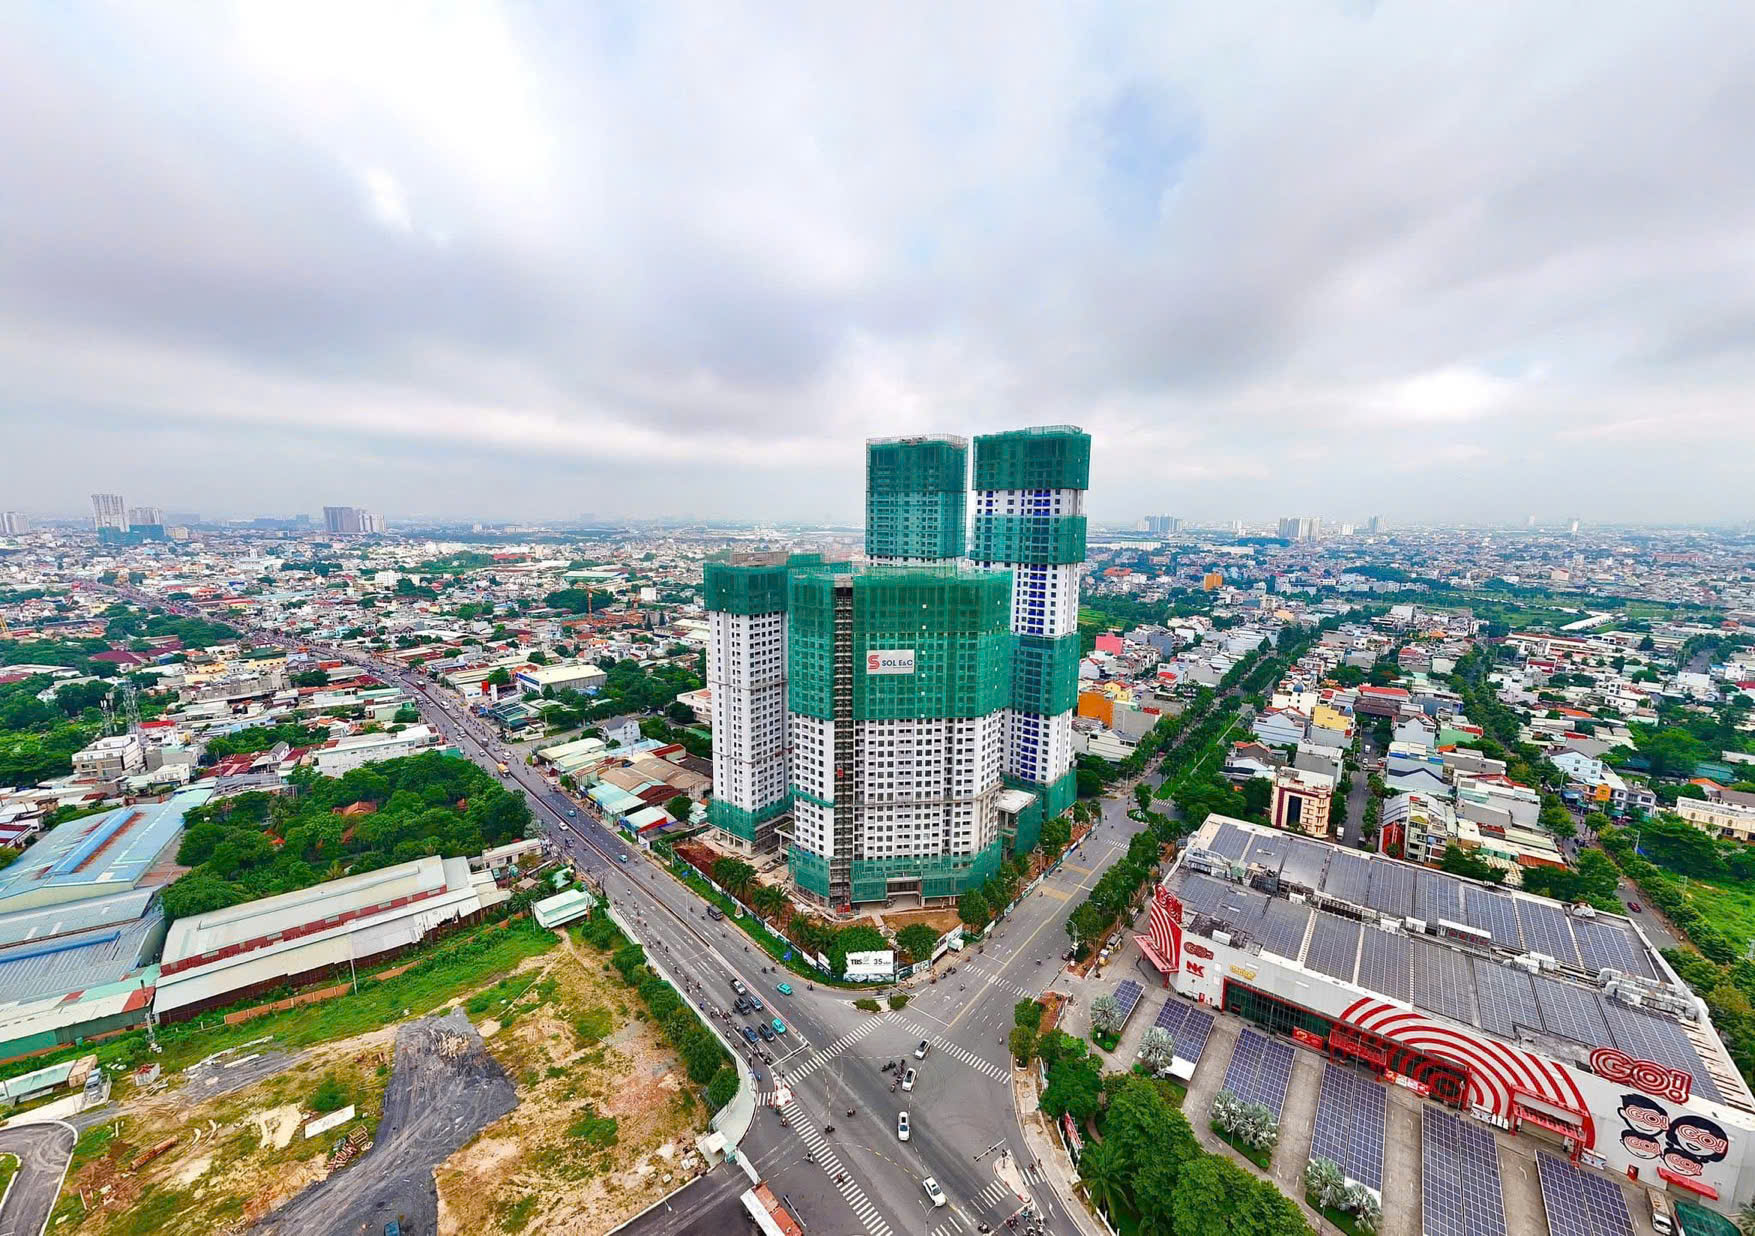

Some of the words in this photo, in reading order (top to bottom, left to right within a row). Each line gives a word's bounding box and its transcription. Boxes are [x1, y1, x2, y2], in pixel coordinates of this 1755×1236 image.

[1590, 1048, 1692, 1105] GO!
[1625, 1105, 1670, 1131] GO!
[1624, 1136, 1662, 1156] GO!
[1678, 1124, 1728, 1154] GO!
[1666, 1153, 1702, 1176] GO!
